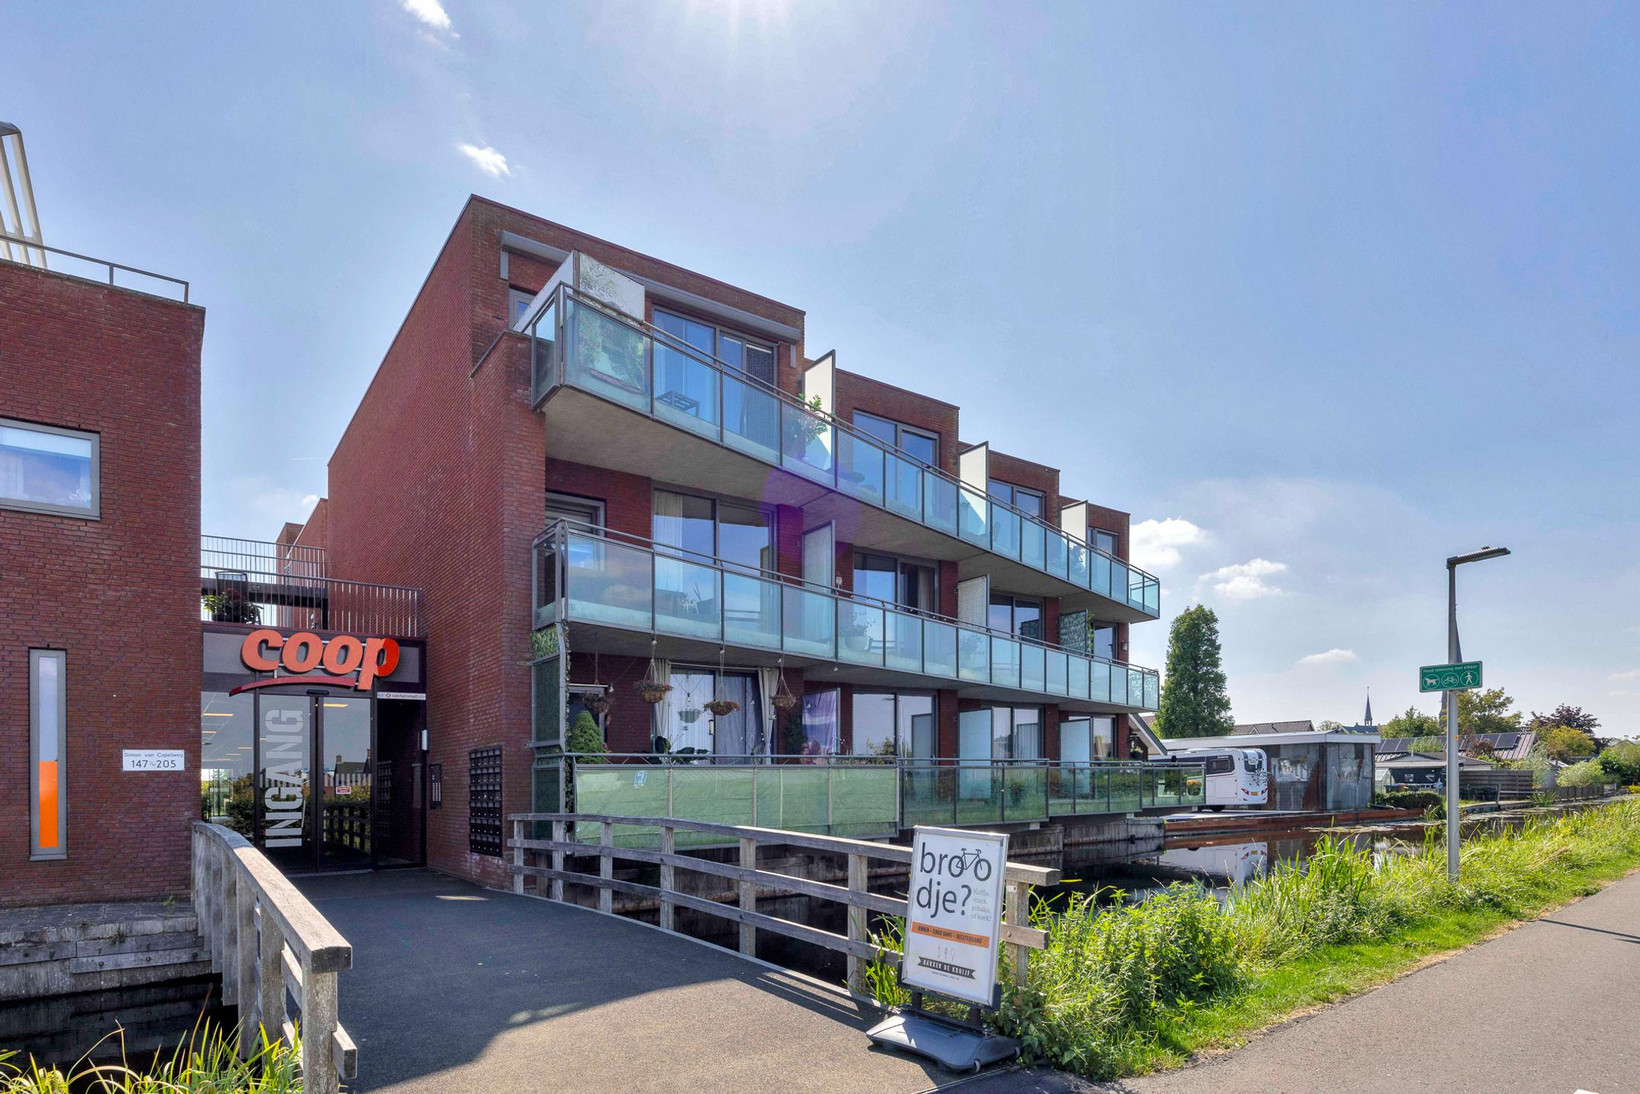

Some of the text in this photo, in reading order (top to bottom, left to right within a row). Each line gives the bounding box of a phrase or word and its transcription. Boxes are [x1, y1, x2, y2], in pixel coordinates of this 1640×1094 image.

[242, 629, 400, 690] coop
[131, 759, 148, 768] 147
[156, 759, 177, 769] 205
[265, 709, 303, 848] INGANG
[916, 877, 972, 919] dje?
[923, 959, 942, 969] BAKKER
[943, 964, 951, 972] DE
